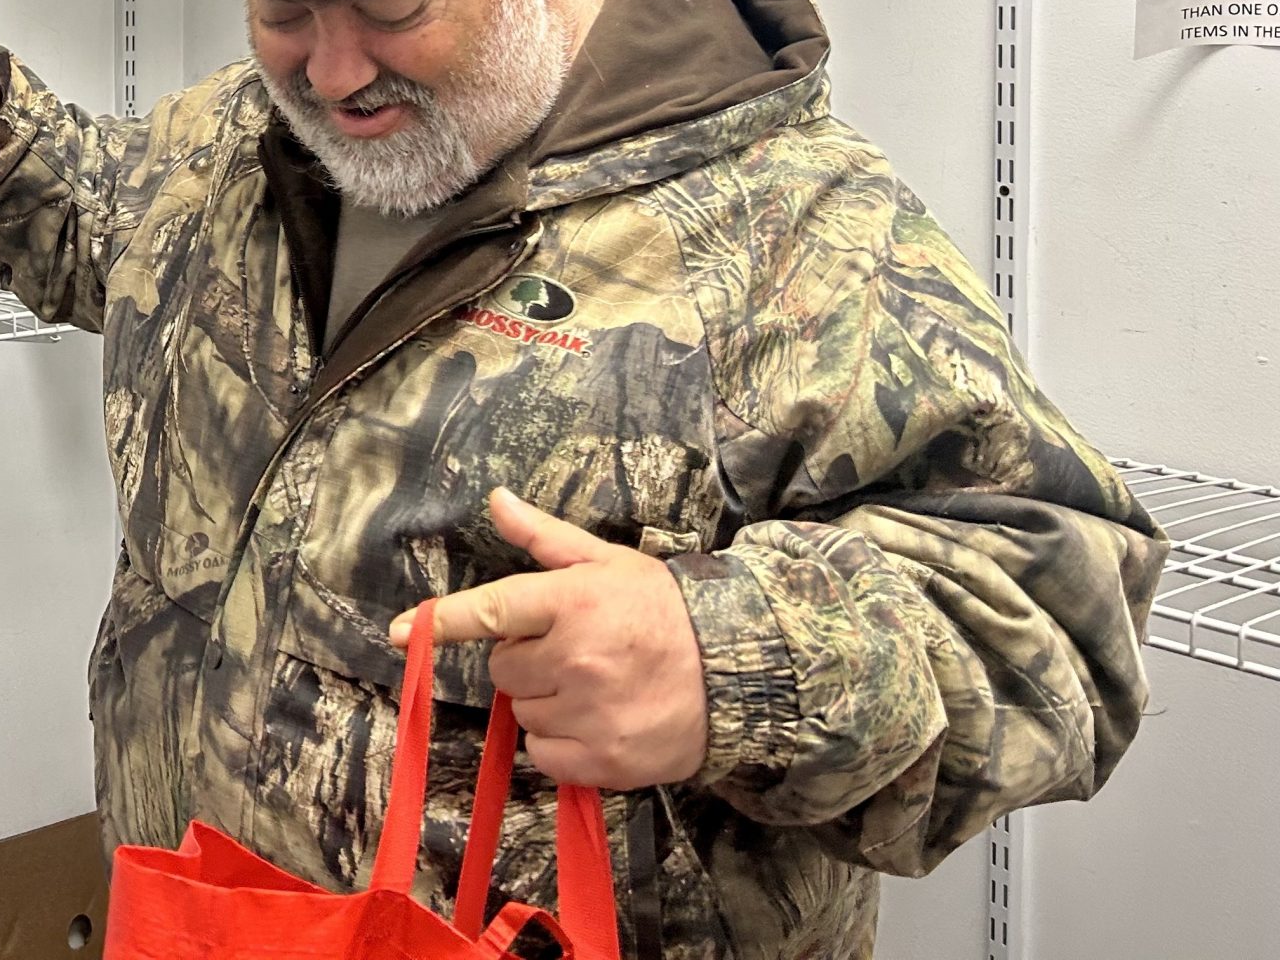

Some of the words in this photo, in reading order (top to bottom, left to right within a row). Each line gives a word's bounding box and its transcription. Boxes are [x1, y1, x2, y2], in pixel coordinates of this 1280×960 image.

[1180, 4, 1223, 20] THAN
[1228, 3, 1262, 16] ONE
[1181, 25, 1228, 40] ITEMS
[1233, 25, 1249, 37] IN
[536, 330, 592, 353] OAK
[166, 559, 200, 578] MOSSY
[202, 556, 227, 569] OAK
